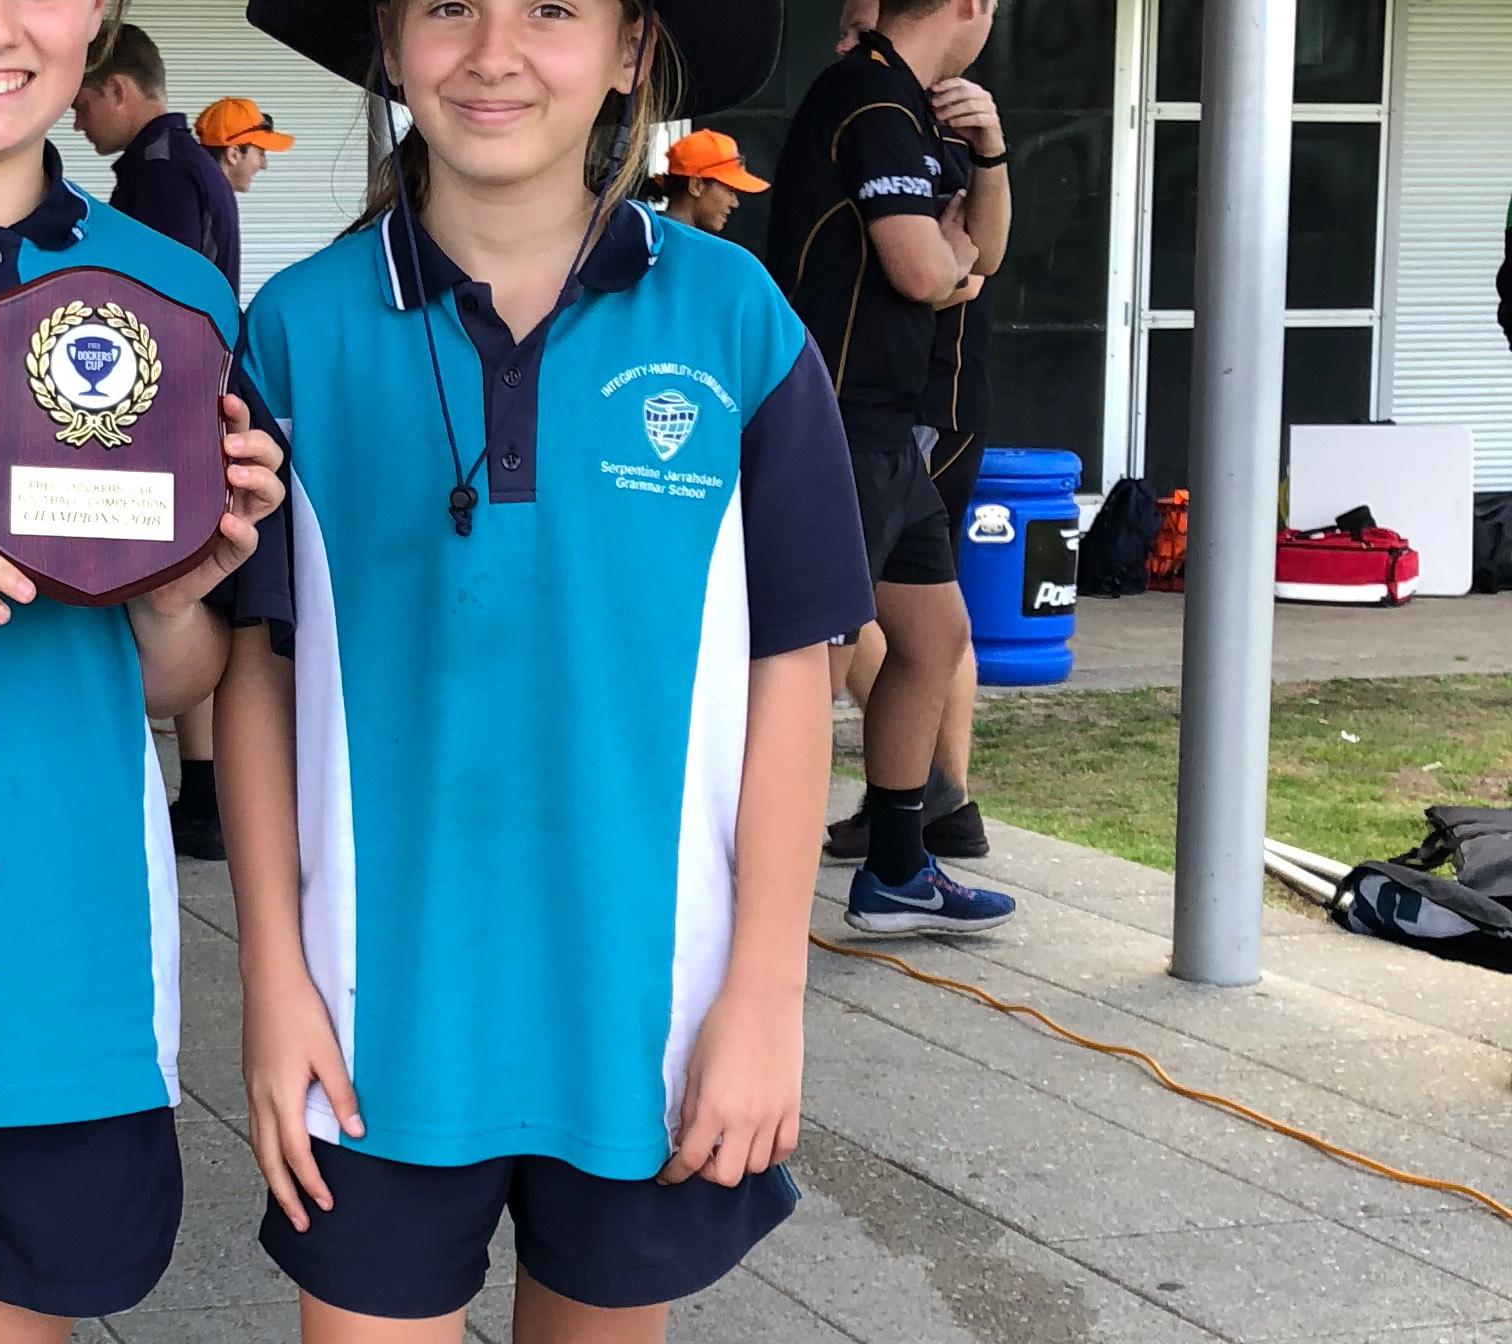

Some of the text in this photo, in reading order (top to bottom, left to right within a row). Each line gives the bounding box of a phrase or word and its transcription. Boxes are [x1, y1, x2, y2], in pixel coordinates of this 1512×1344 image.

[77, 351, 112, 362] DOCKERS
[85, 360, 104, 371] CUP
[600, 460, 724, 488] Serpentine Jarrahdale
[615, 476, 706, 499] Grammar School
